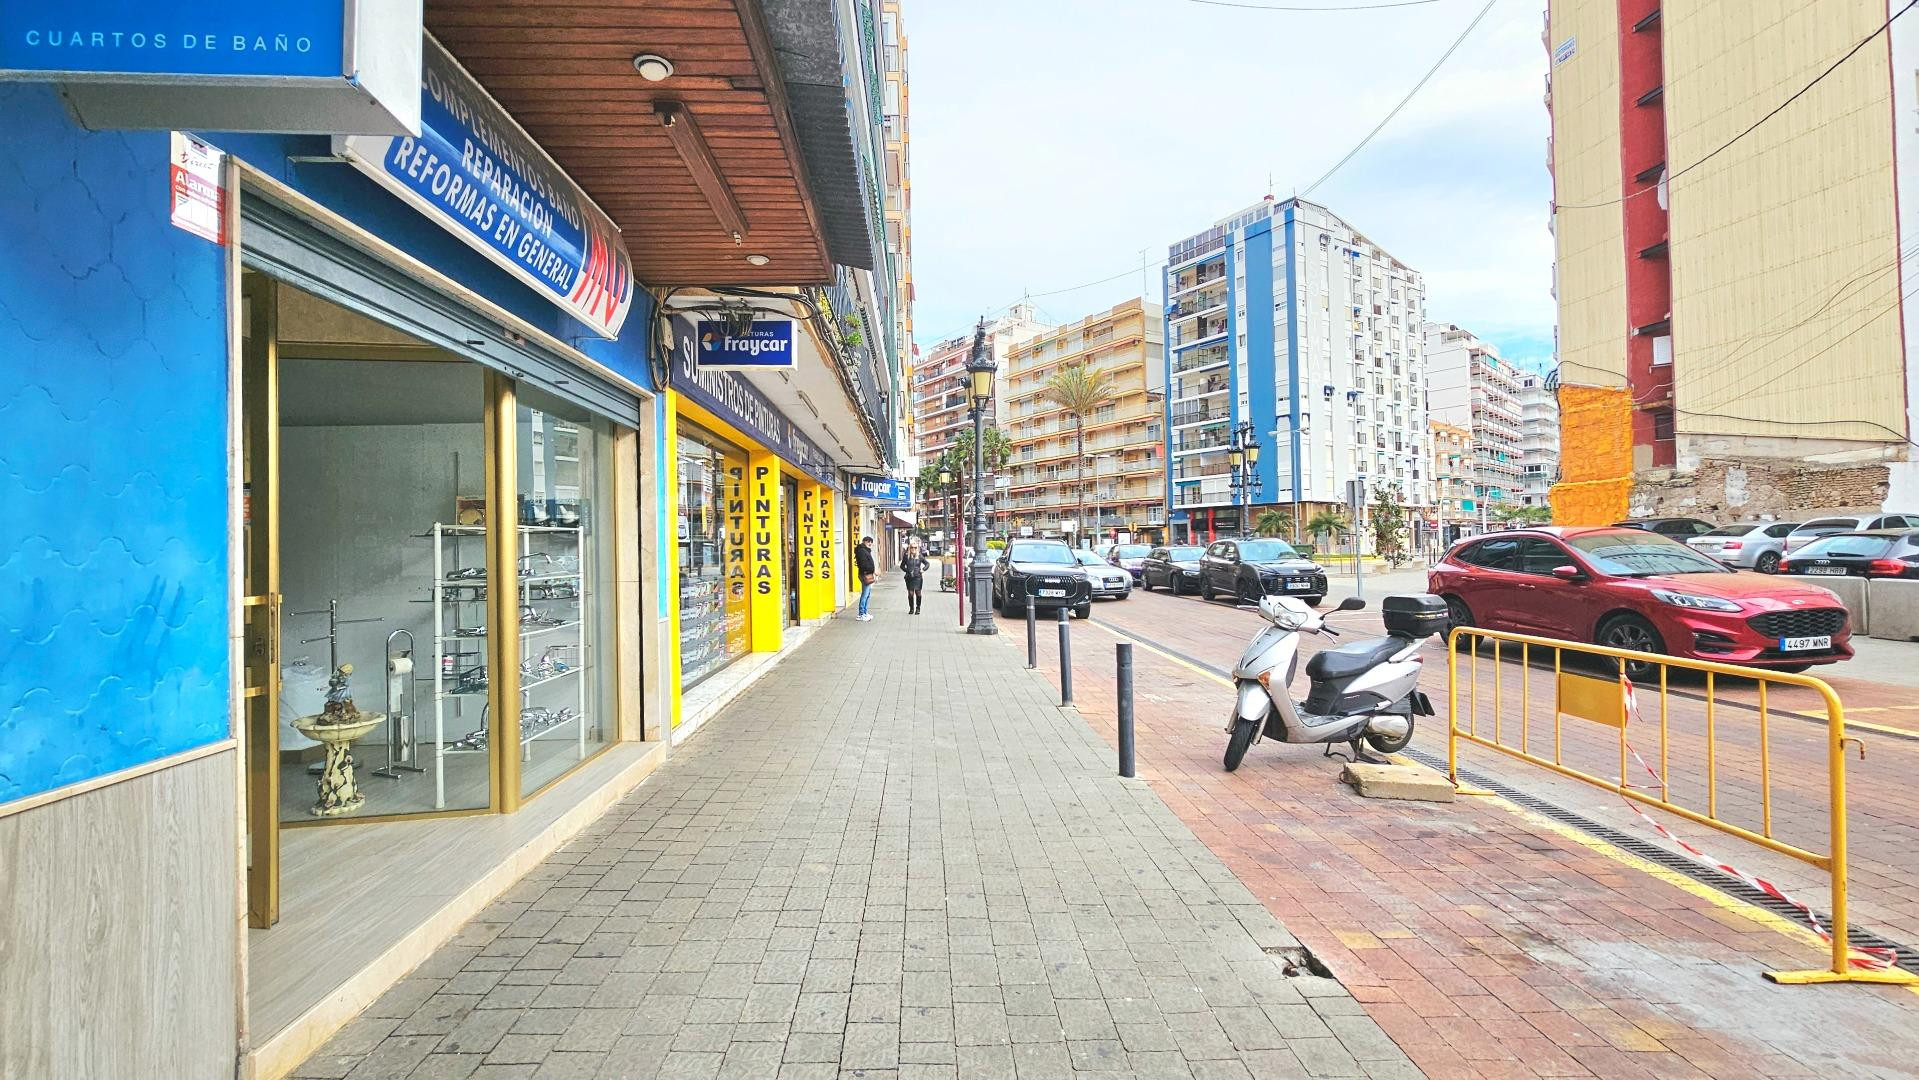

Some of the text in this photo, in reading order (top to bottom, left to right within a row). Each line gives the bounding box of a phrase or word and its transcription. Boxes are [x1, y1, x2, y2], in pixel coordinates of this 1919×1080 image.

[26, 30, 311, 52] CUARTOS DE BAÑO
[423, 67, 545, 199] OMPLEMENTOS
[547, 182, 580, 231] BAÑO
[462, 138, 553, 239] REPARACION
[393, 136, 573, 291] REFORMAS EN GENERAL
[725, 336, 788, 356] fraycar
[744, 390, 754, 425] DE
[754, 397, 780, 445] PINTURAS
[861, 477, 892, 497] fraycar
[755, 466, 771, 595] PINTURAS
[803, 490, 814, 579] PINTURAS
[820, 499, 831, 579] PINTURAS
[1787, 637, 1829, 649] 4497 MNR
